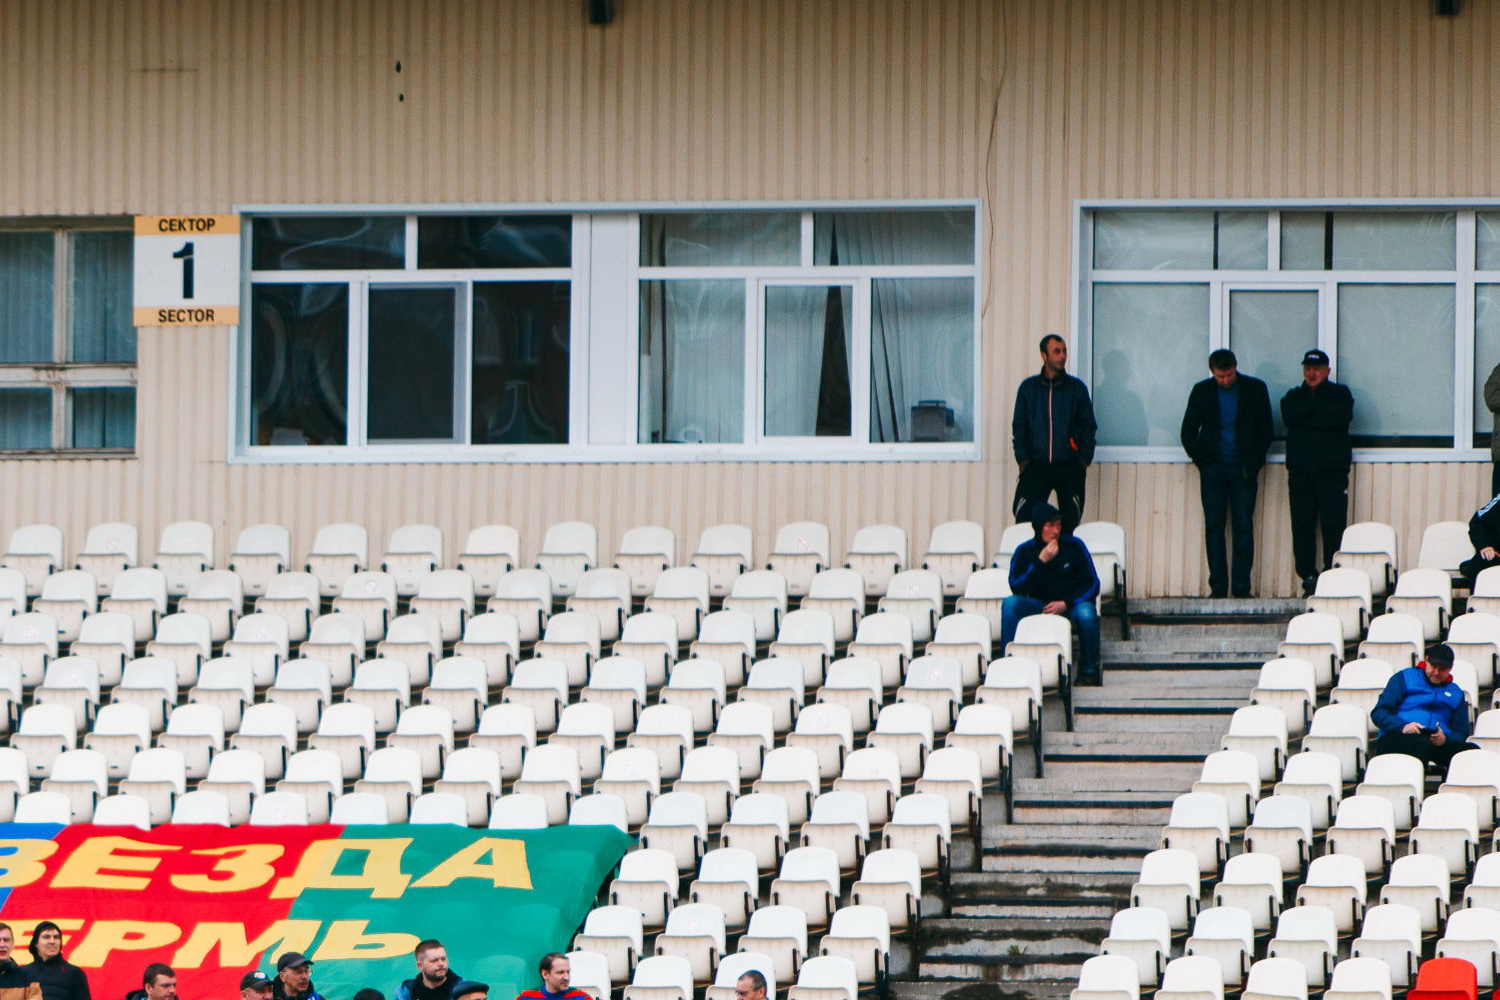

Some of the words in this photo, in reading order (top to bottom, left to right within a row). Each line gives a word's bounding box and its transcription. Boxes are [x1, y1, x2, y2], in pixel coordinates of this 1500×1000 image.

[158, 218, 216, 232] СЕКТОР
[172, 241, 194, 299] 1
[158, 309, 215, 323] SECTOR
